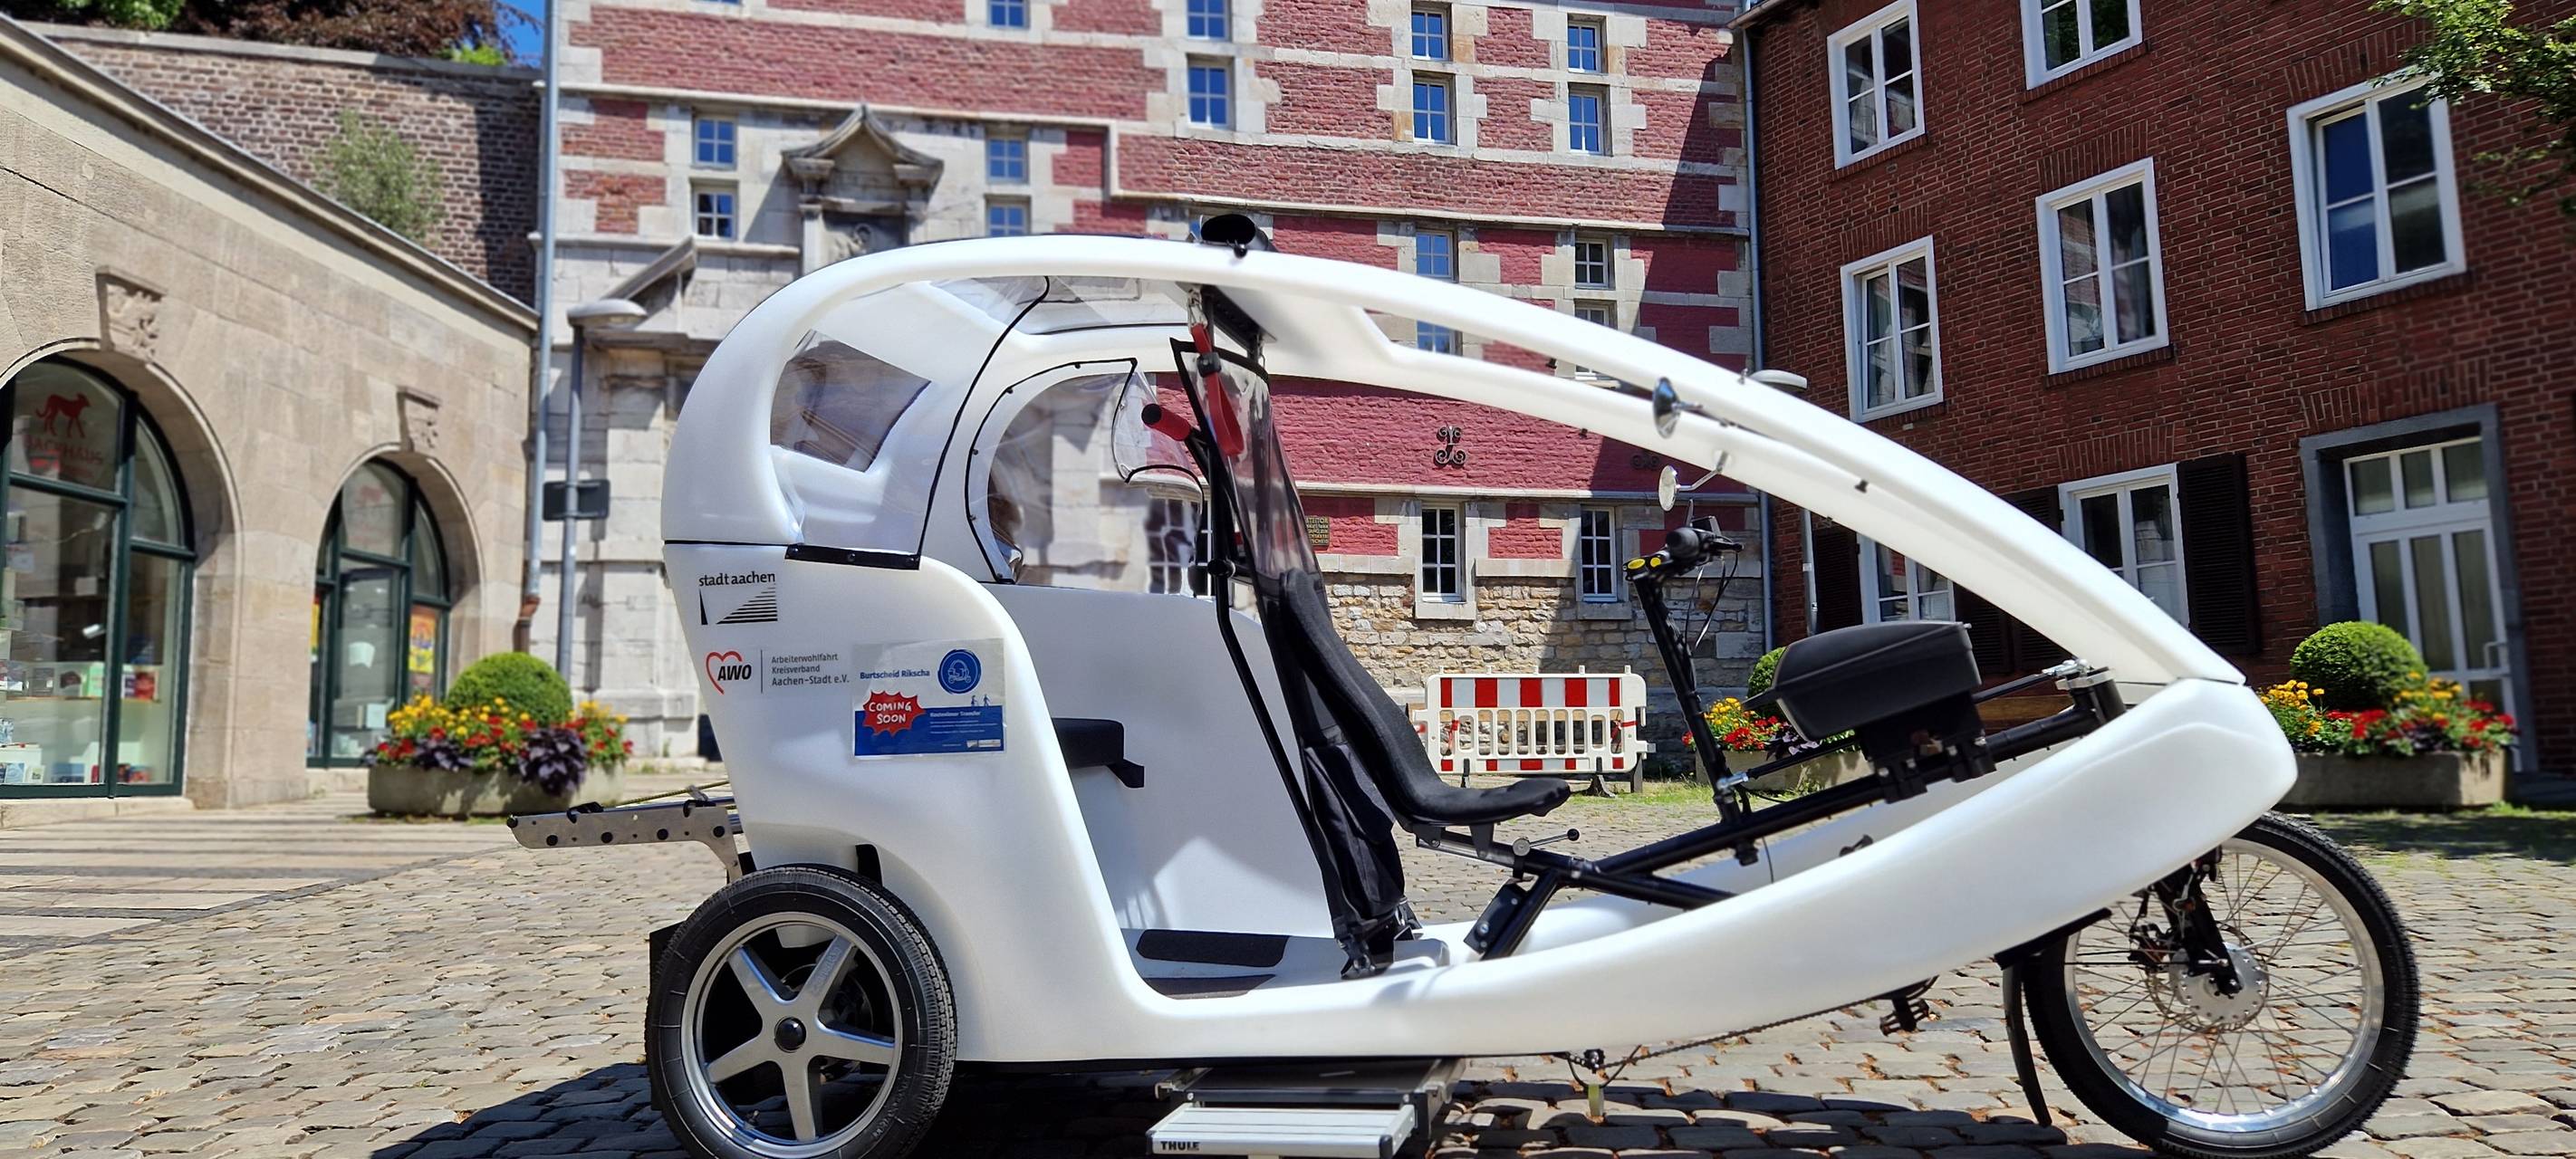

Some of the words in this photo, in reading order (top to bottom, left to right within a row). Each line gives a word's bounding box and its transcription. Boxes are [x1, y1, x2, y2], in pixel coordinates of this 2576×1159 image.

[698, 572, 729, 587] stadt
[731, 570, 775, 584] aachen
[772, 653, 839, 664] Arbeiterwohlfahrt
[717, 664, 752, 681] AWO
[772, 665, 821, 675] Kreisverband
[860, 669, 899, 679] Burtscheid
[901, 668, 930, 677] Rikscha
[772, 675, 831, 686] Aachen-Stadt
[833, 675, 850, 683] e.V.
[869, 701, 912, 713] COMING
[876, 714, 906, 724] SOON
[1160, 1141, 1200, 1151] THULE
